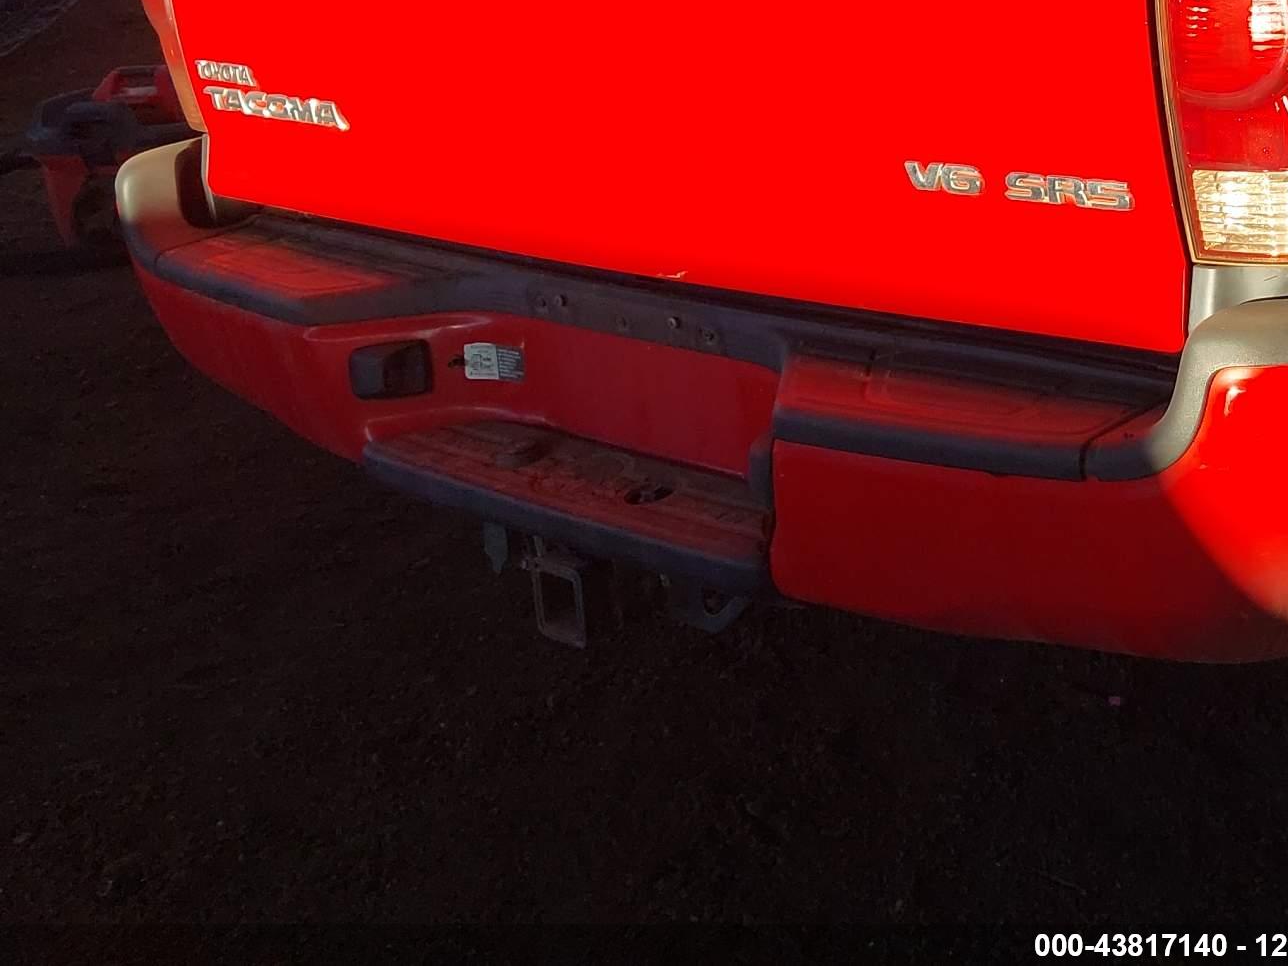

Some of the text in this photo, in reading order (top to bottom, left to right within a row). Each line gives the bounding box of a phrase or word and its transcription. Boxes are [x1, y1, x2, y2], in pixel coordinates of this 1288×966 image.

[195, 60, 257, 87] TOYOTA
[203, 86, 350, 131] TACOMA
[904, 160, 985, 196] V6
